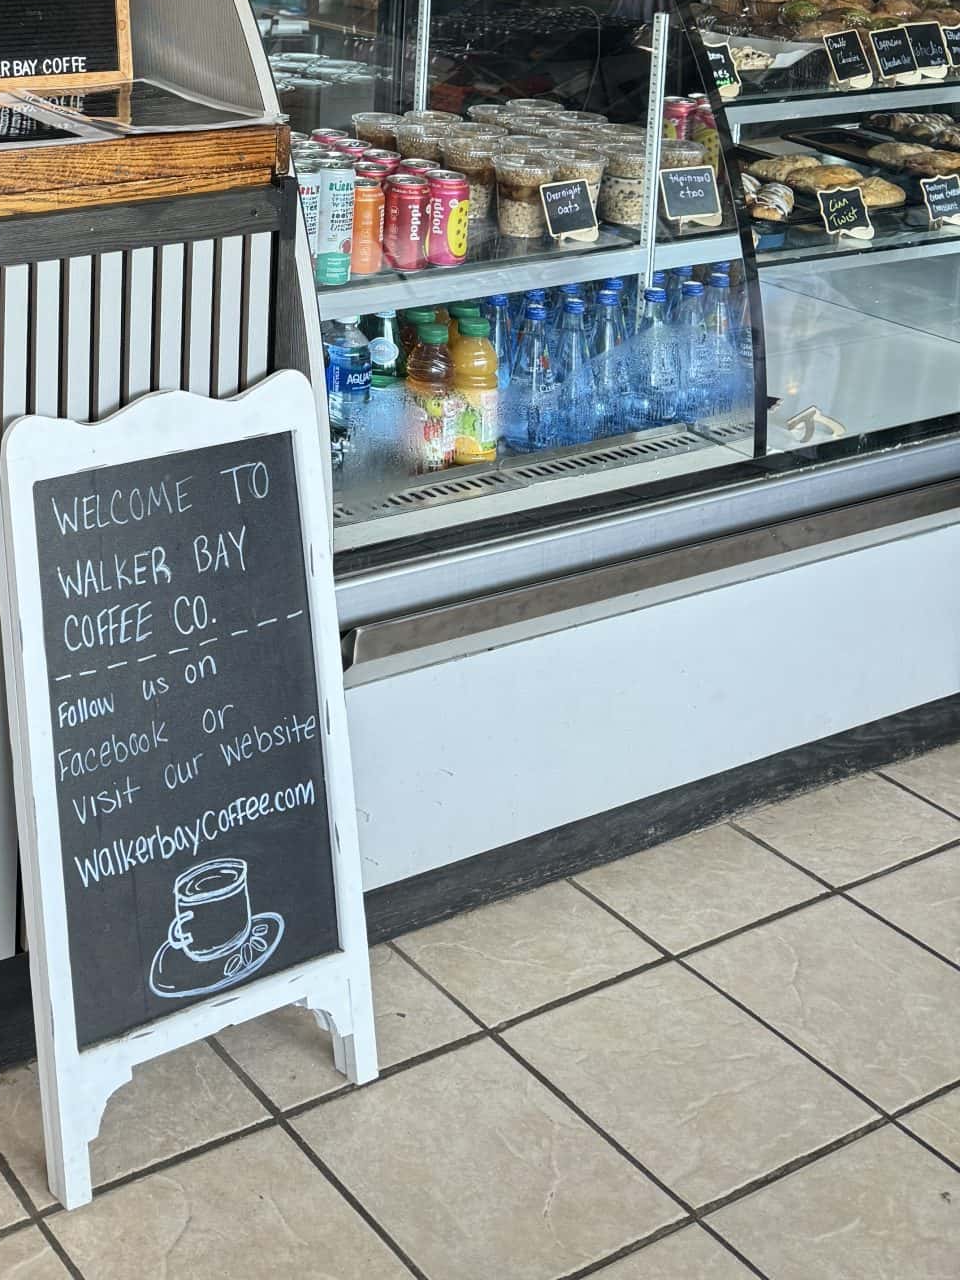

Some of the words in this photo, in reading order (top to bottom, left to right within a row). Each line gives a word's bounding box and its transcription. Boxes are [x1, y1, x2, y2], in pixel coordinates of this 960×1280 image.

[13, 59, 38, 75] BAY
[43, 56, 87, 74] COFFE
[546, 184, 582, 202] Overnight
[408, 204, 421, 241] poppi
[430, 198, 444, 234] poppi
[830, 206, 858, 226] Twist
[51, 475, 192, 535] WELCOME
[220, 461, 269, 505] TO
[57, 546, 172, 599] WALKER
[194, 525, 246, 573] BAY
[64, 600, 153, 651] COFFEE
[174, 595, 217, 635] CO.
[57, 693, 115, 729] Follow
[142, 676, 170, 701] us
[184, 655, 217, 684] on
[57, 720, 169, 782] Facebook
[164, 752, 204, 790] our
